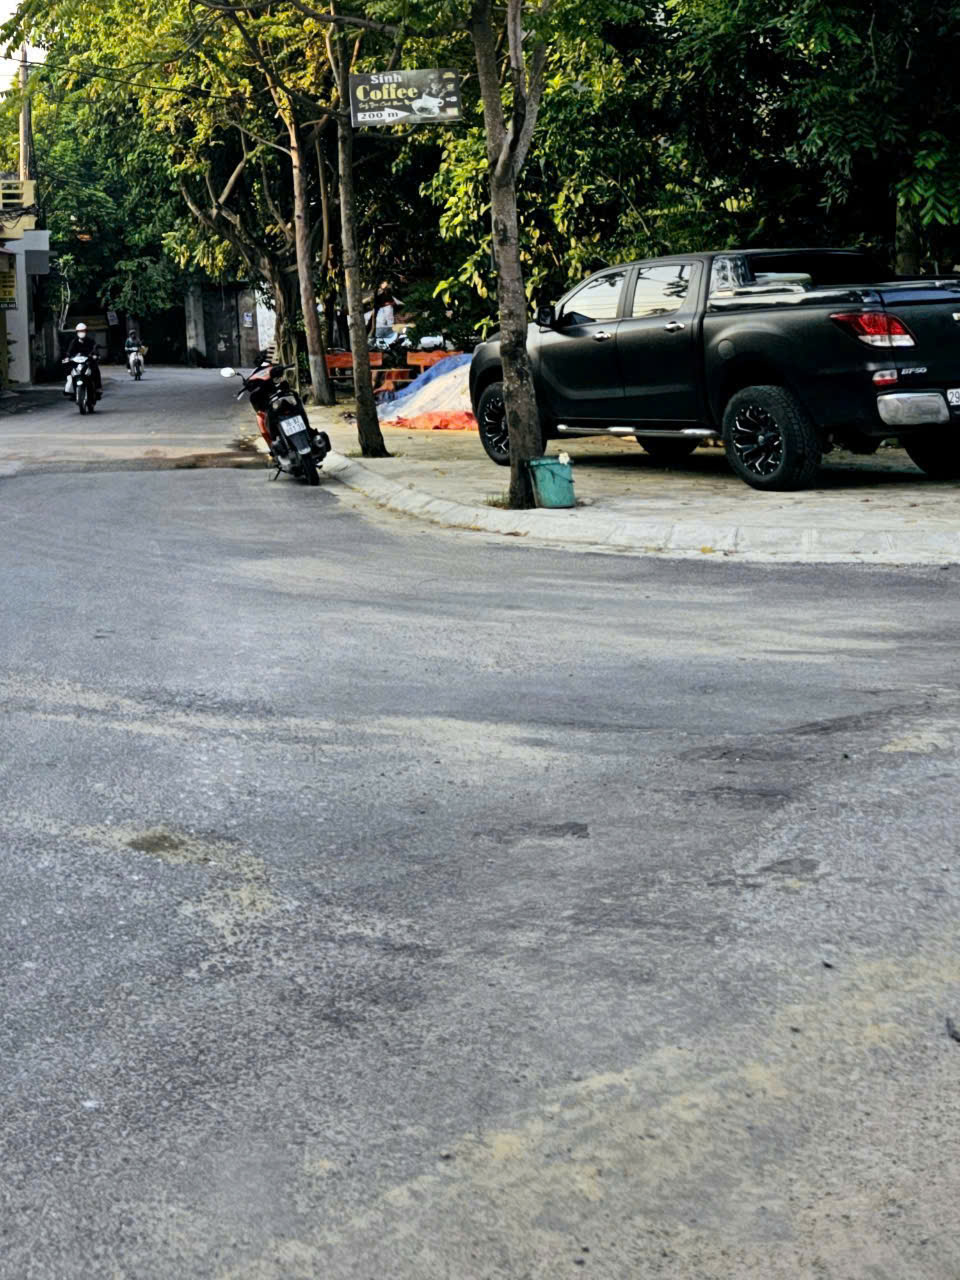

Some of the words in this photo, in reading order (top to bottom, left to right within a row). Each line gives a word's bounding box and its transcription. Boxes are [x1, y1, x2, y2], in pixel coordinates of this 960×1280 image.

[371, 73, 402, 83] Sinh
[356, 84, 418, 101] Coffee
[360, 111, 384, 120] 200
[948, 390, 960, 404] 29
